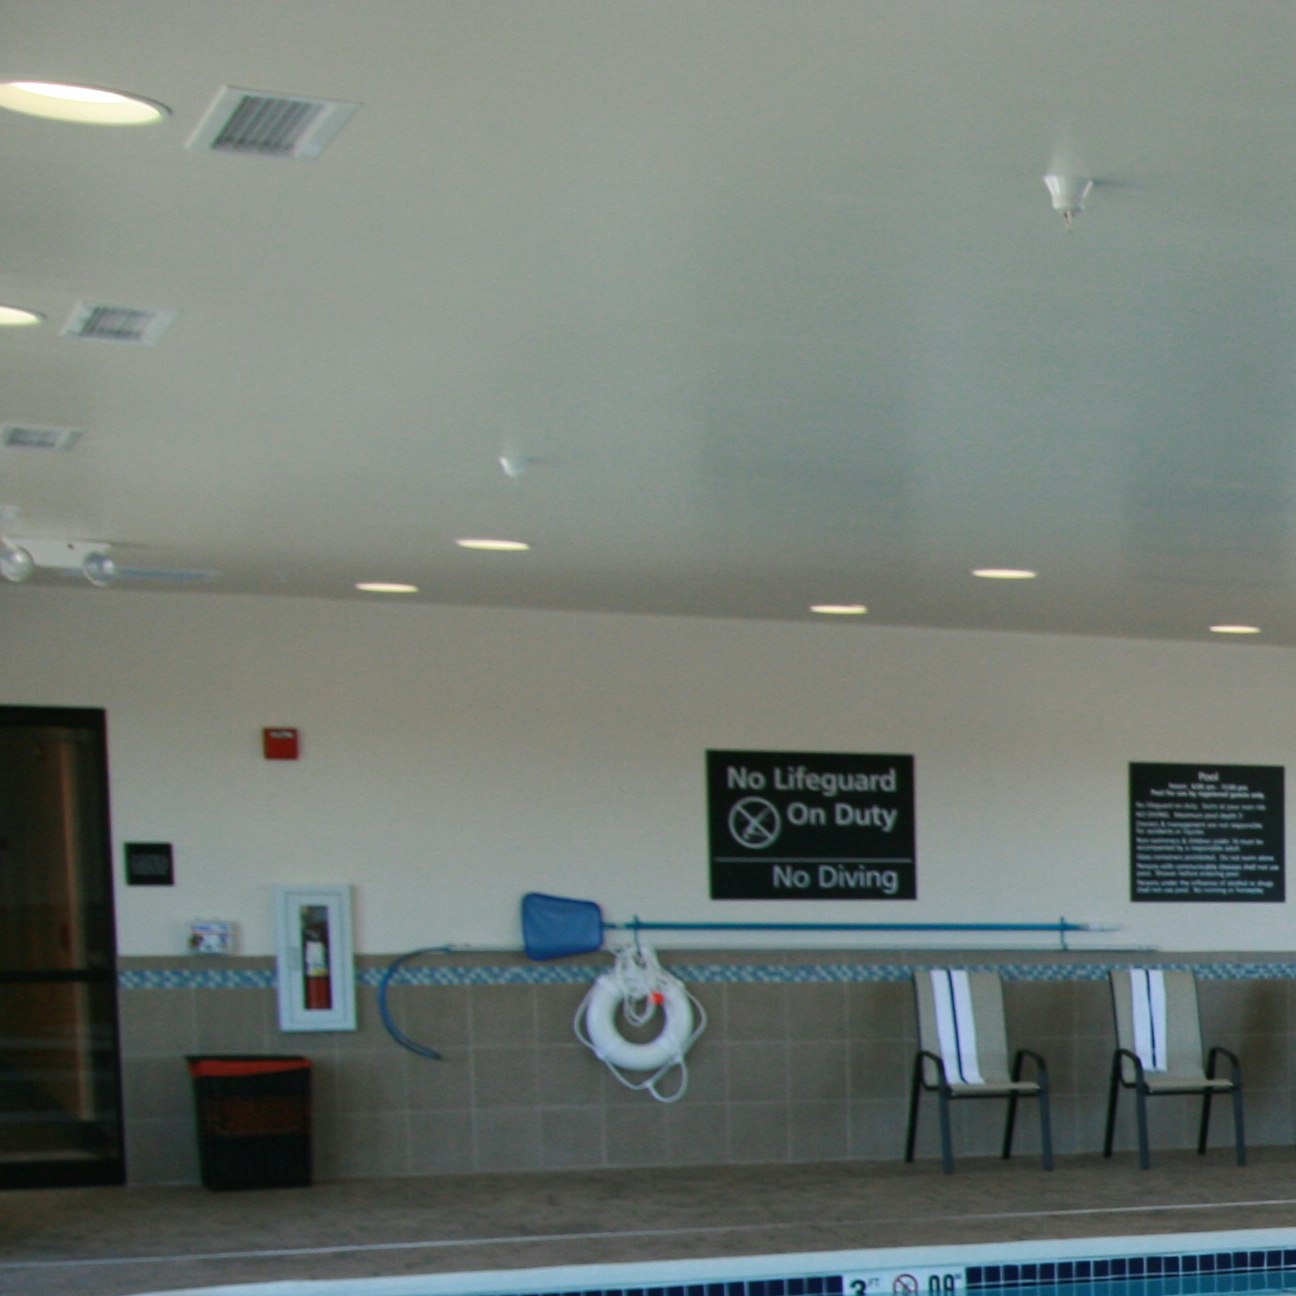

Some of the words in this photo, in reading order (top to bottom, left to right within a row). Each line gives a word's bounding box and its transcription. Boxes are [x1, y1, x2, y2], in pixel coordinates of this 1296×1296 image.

[727, 766, 765, 790] No
[774, 766, 897, 797] Lifeguard
[787, 803, 825, 825] On
[835, 803, 897, 831] Duty
[773, 865, 811, 888] No
[819, 866, 899, 893] Diving
